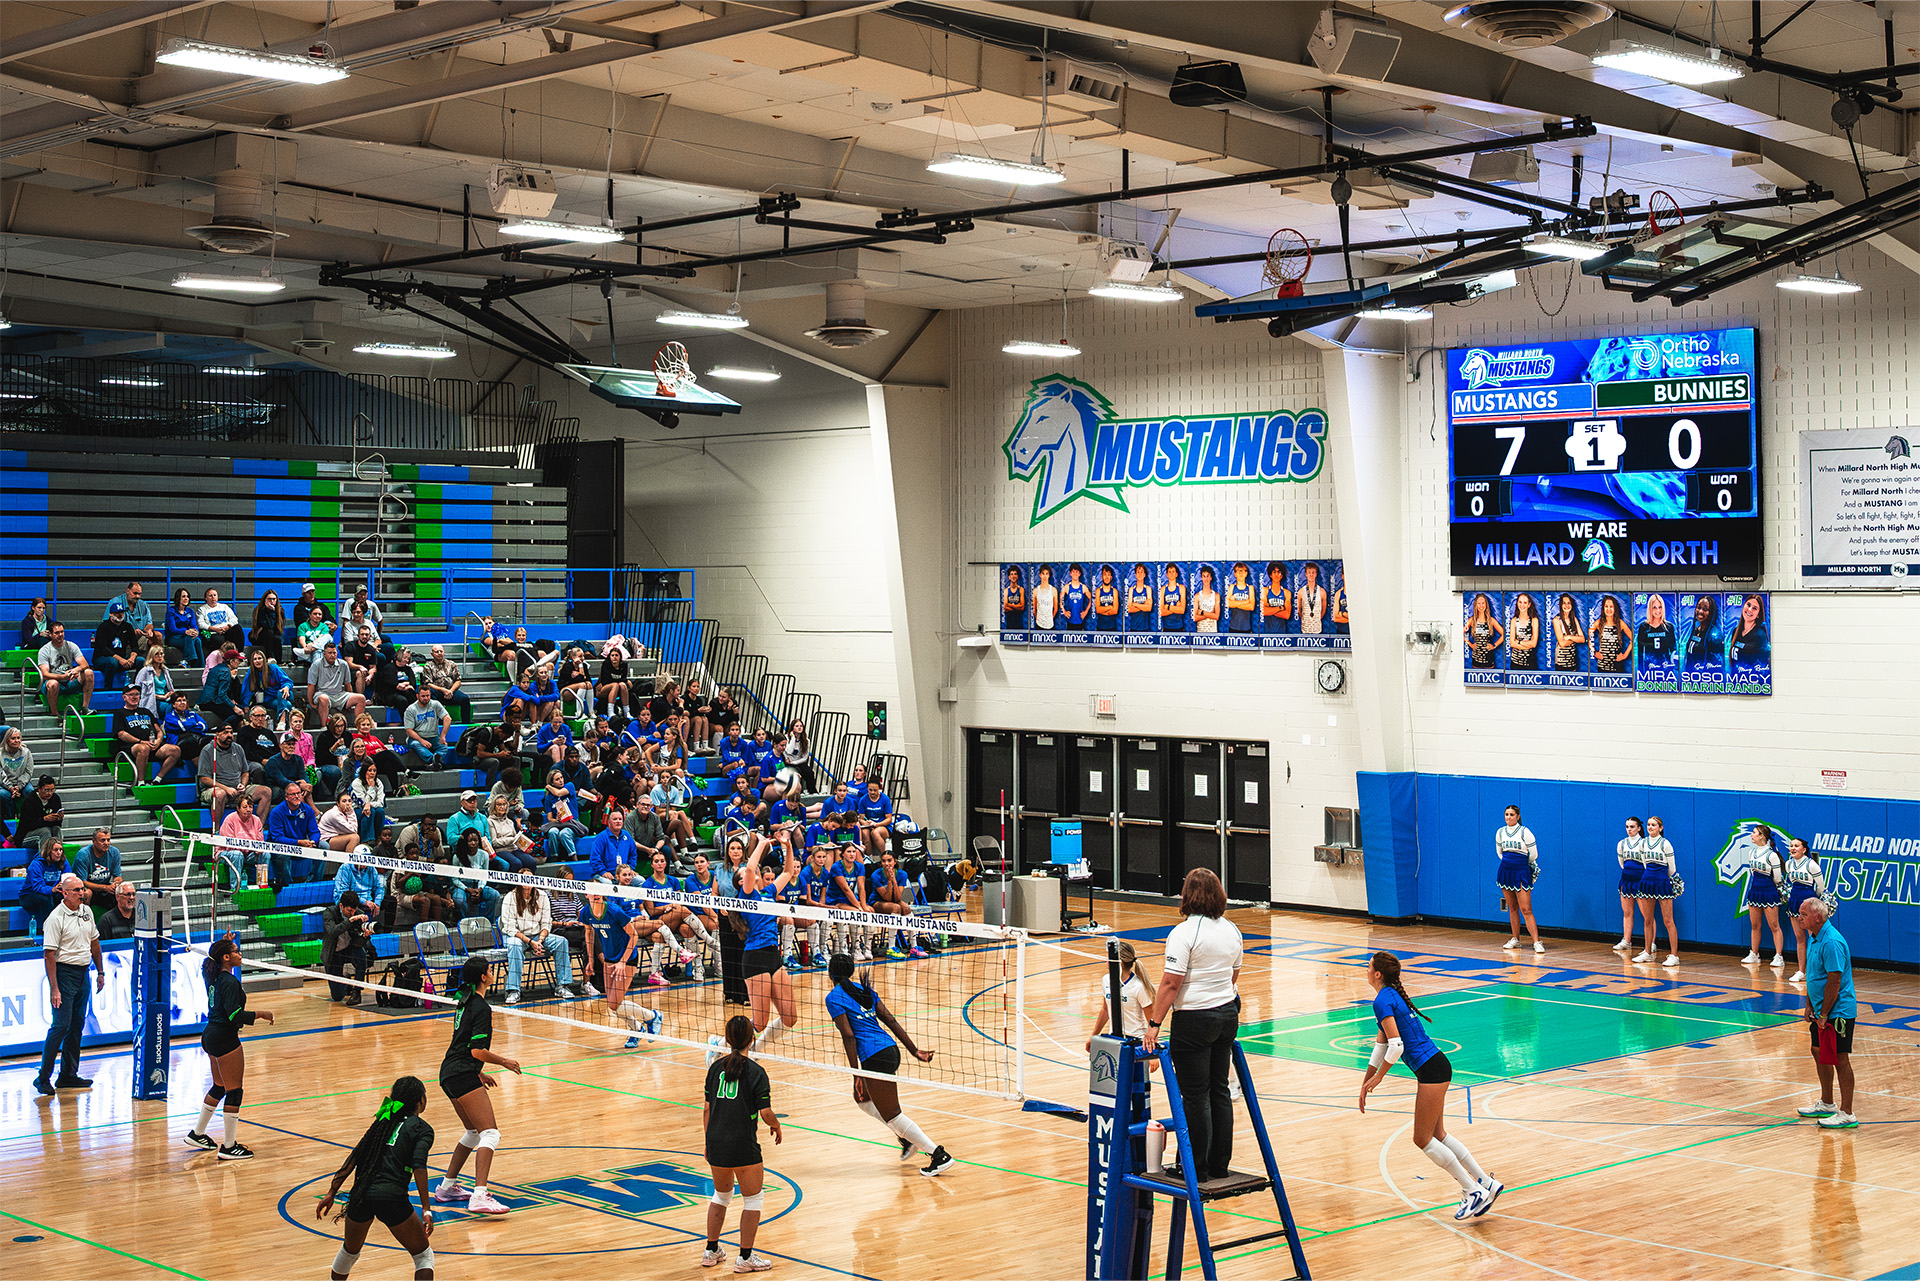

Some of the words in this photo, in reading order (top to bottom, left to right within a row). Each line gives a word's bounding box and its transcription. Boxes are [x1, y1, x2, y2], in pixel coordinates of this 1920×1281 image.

[1661, 337, 1710, 353] Ortho
[1662, 350, 1740, 369] Nebraska
[1488, 359, 1552, 377] MUSTANGS
[1654, 379, 1746, 402] BUNNIES
[1455, 390, 1558, 412] MUSTANGS
[1584, 424, 1606, 433] SET
[1091, 413, 1323, 482] MUSTANGS
[1495, 427, 1526, 475] 7
[1587, 437, 1605, 466] 1
[1668, 419, 1701, 469] 0
[1837, 464, 1864, 472] Millard
[1866, 463, 1888, 471] North
[1890, 463, 1908, 471] High
[1894, 475, 1912, 484] again
[1881, 487, 1903, 495] North
[1471, 495, 1484, 516] 0
[1717, 489, 1731, 510] 0
[1844, 500, 1856, 508] And
[1836, 512, 1844, 520] So
[1567, 522, 1593, 538] WE
[1596, 522, 1627, 538] ARE
[1887, 524, 1905, 532] High
[1849, 536, 1861, 544] And
[1863, 536, 1877, 545] push
[1474, 541, 1574, 566] MILLARD
[1630, 540, 1718, 565] NORTH
[1864, 548, 1878, 557] keep
[1635, 594, 1647, 605] #6
[1727, 595, 1743, 606] #16
[1637, 670, 1677, 681] MIRA
[1681, 672, 1723, 683] SOSO
[1726, 673, 1771, 684] MACY
[1637, 681, 1677, 692] BONIN
[1682, 682, 1725, 692] MARIN
[1726, 683, 1771, 694] RANDS
[1099, 699, 1111, 712] EXIT
[225, 838, 250, 848] MILLARD
[251, 841, 270, 851] NORTH
[271, 844, 303, 855] MUSTANGS
[1812, 833, 1885, 853] MILLARD
[348, 853, 376, 865] MILLARD
[378, 857, 400, 868] NORTH
[401, 861, 436, 872] MUSTANGS
[488, 870, 520, 882] MILLARD
[520, 874, 545, 886] NORTH
[547, 878, 587, 891] MUSTANGS
[1819, 857, 1920, 905] USTAN
[646, 888, 681, 901] MILLARD
[683, 892, 711, 905] NORTH
[713, 896, 758, 911] MUSTANGS
[827, 909, 868, 924] MILLARD
[871, 914, 902, 927] NORTH
[905, 917, 958, 932] MUSTANGS
[135, 939, 145, 1026] MILLARD
[716, 1070, 739, 1099] 10
